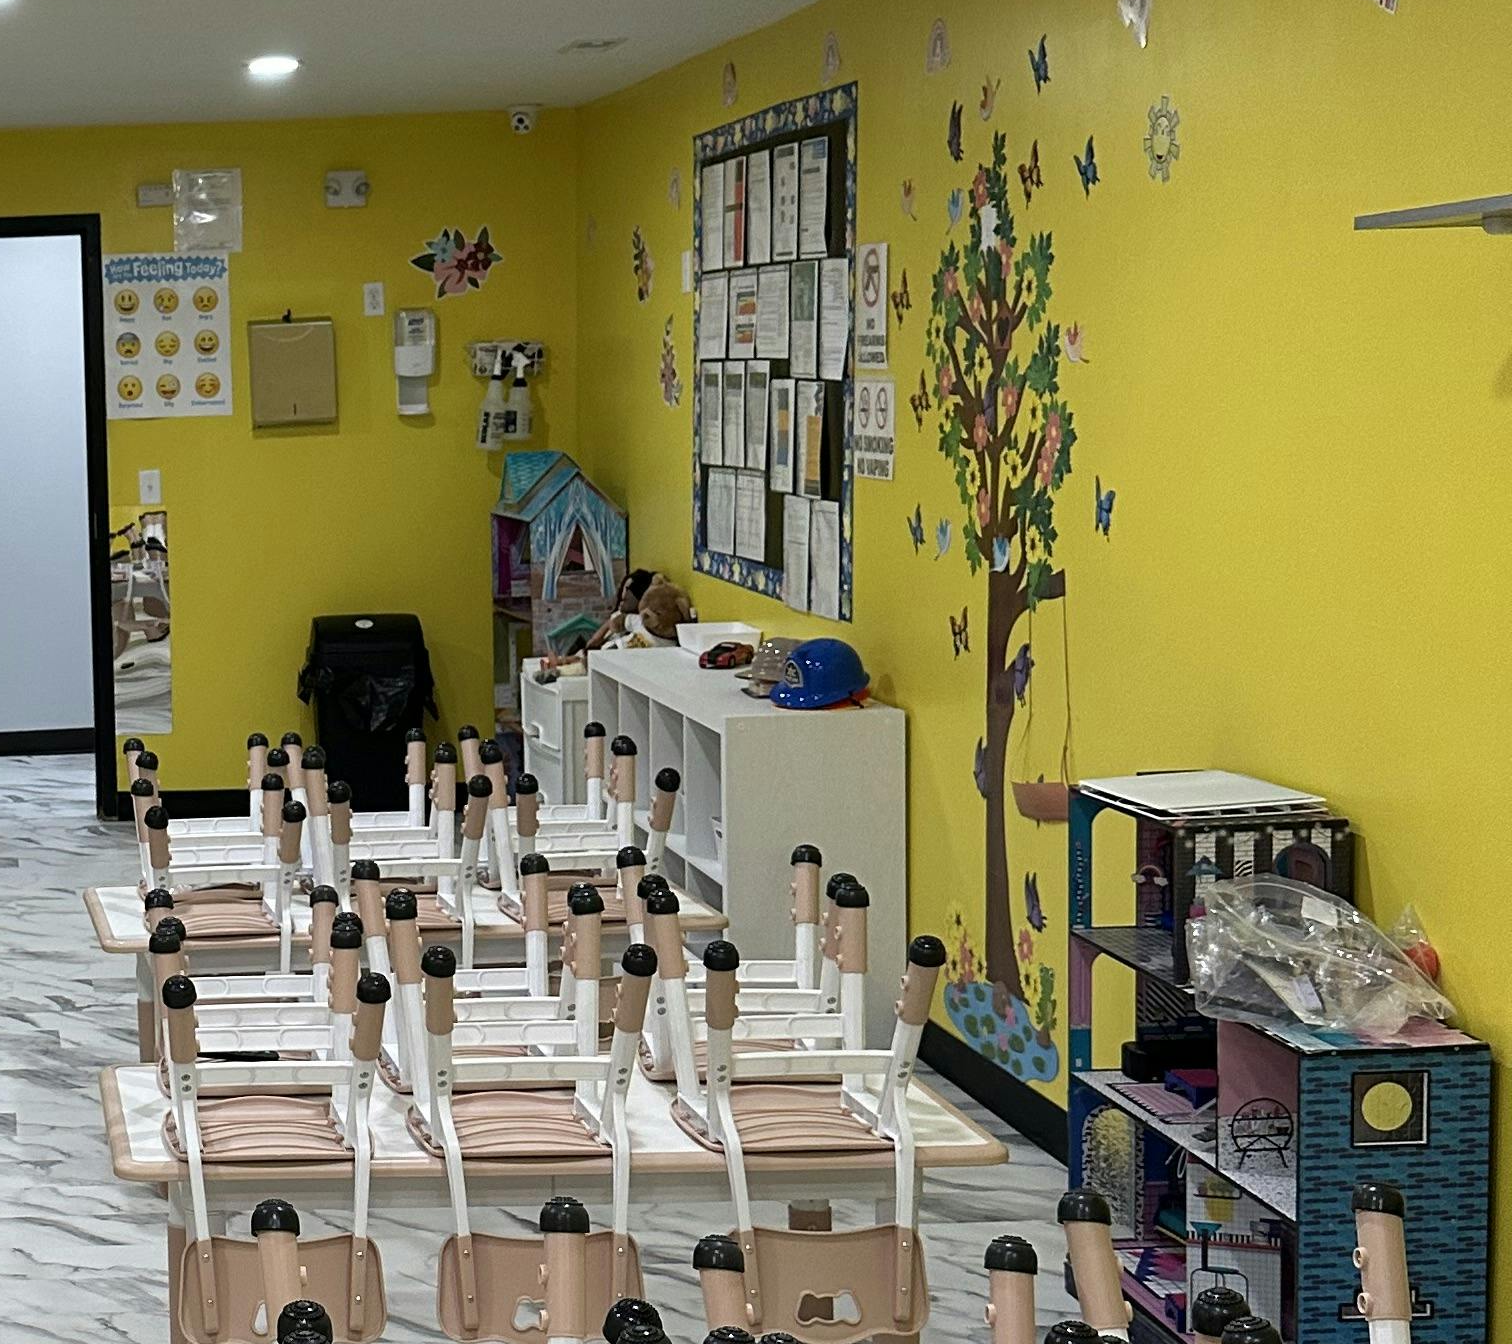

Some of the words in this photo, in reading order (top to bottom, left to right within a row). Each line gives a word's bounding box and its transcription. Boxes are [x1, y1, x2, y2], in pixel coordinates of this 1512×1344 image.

[132, 261, 183, 277] Feeling
[186, 262, 223, 276] Today?
[864, 436, 894, 455] SMOKING
